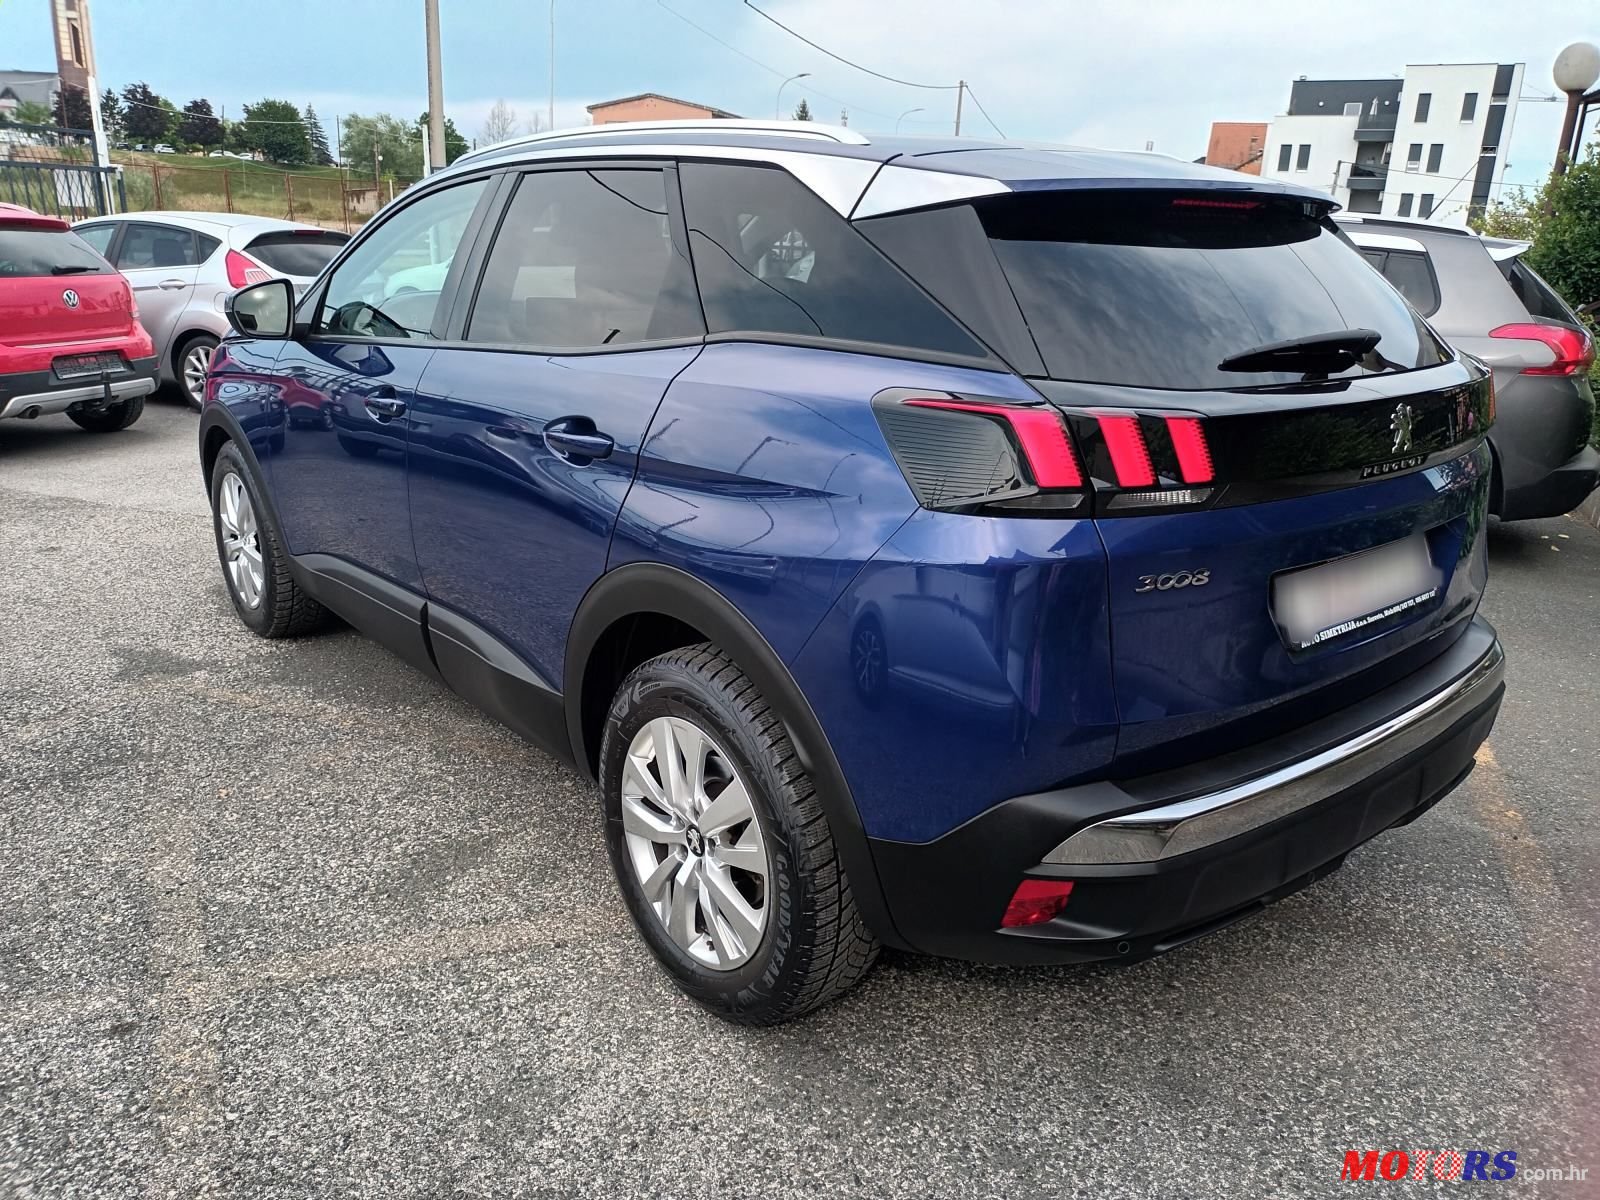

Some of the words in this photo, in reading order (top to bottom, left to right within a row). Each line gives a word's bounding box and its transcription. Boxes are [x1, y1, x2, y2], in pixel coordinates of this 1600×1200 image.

[1363, 456, 1424, 477] PEUGEOT
[1135, 567, 1211, 593] 3008
[1319, 620, 1357, 641] SIMETRIJA
[762, 854, 792, 988] GOODYEAR
